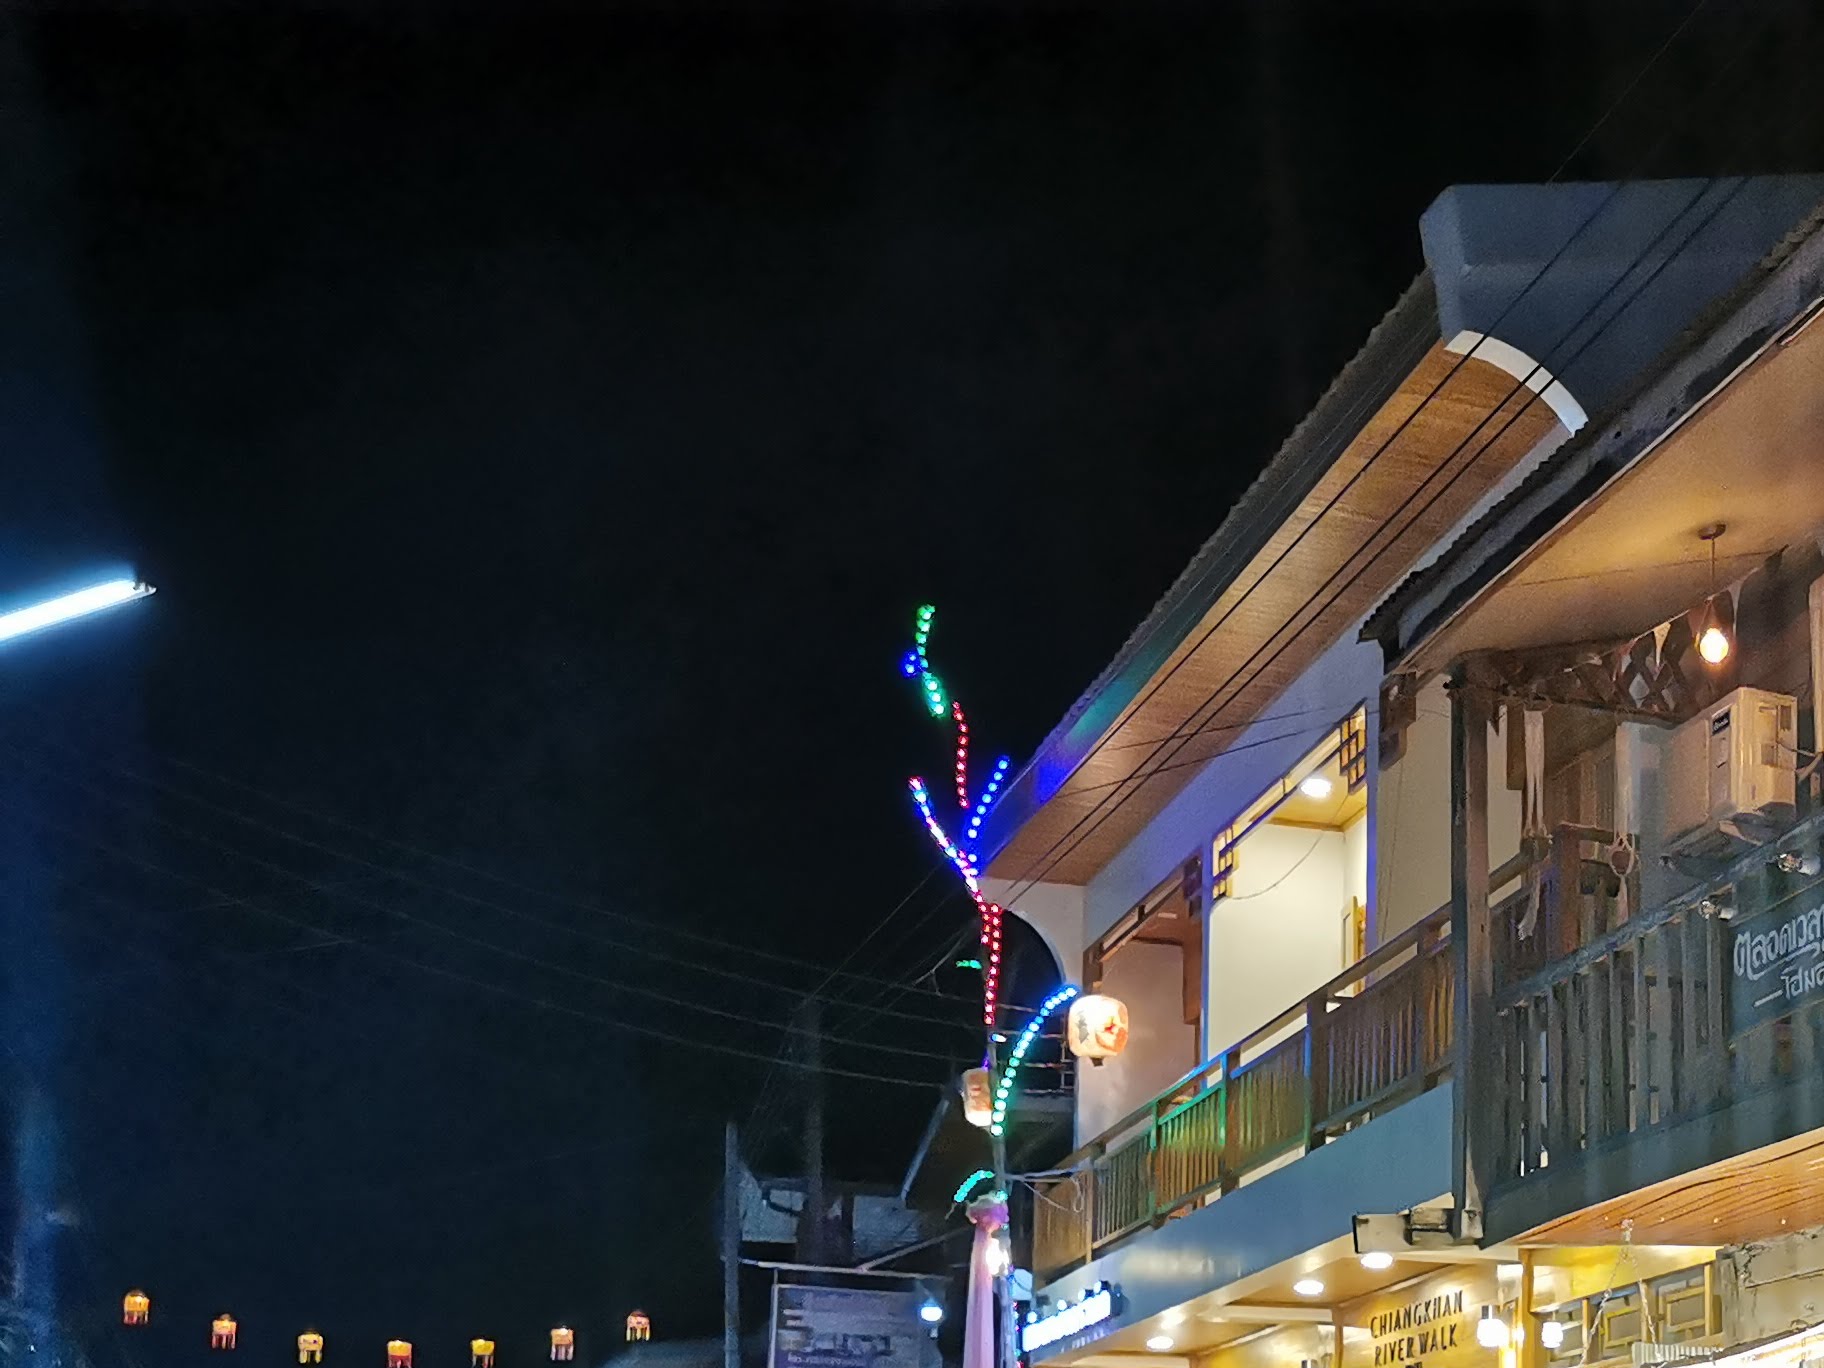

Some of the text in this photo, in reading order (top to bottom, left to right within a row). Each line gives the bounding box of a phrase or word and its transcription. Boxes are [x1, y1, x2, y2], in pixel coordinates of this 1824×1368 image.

[1370, 1289, 1463, 1339] CHIANGKHAN
[1374, 1322, 1458, 1368] RIVER WALK
